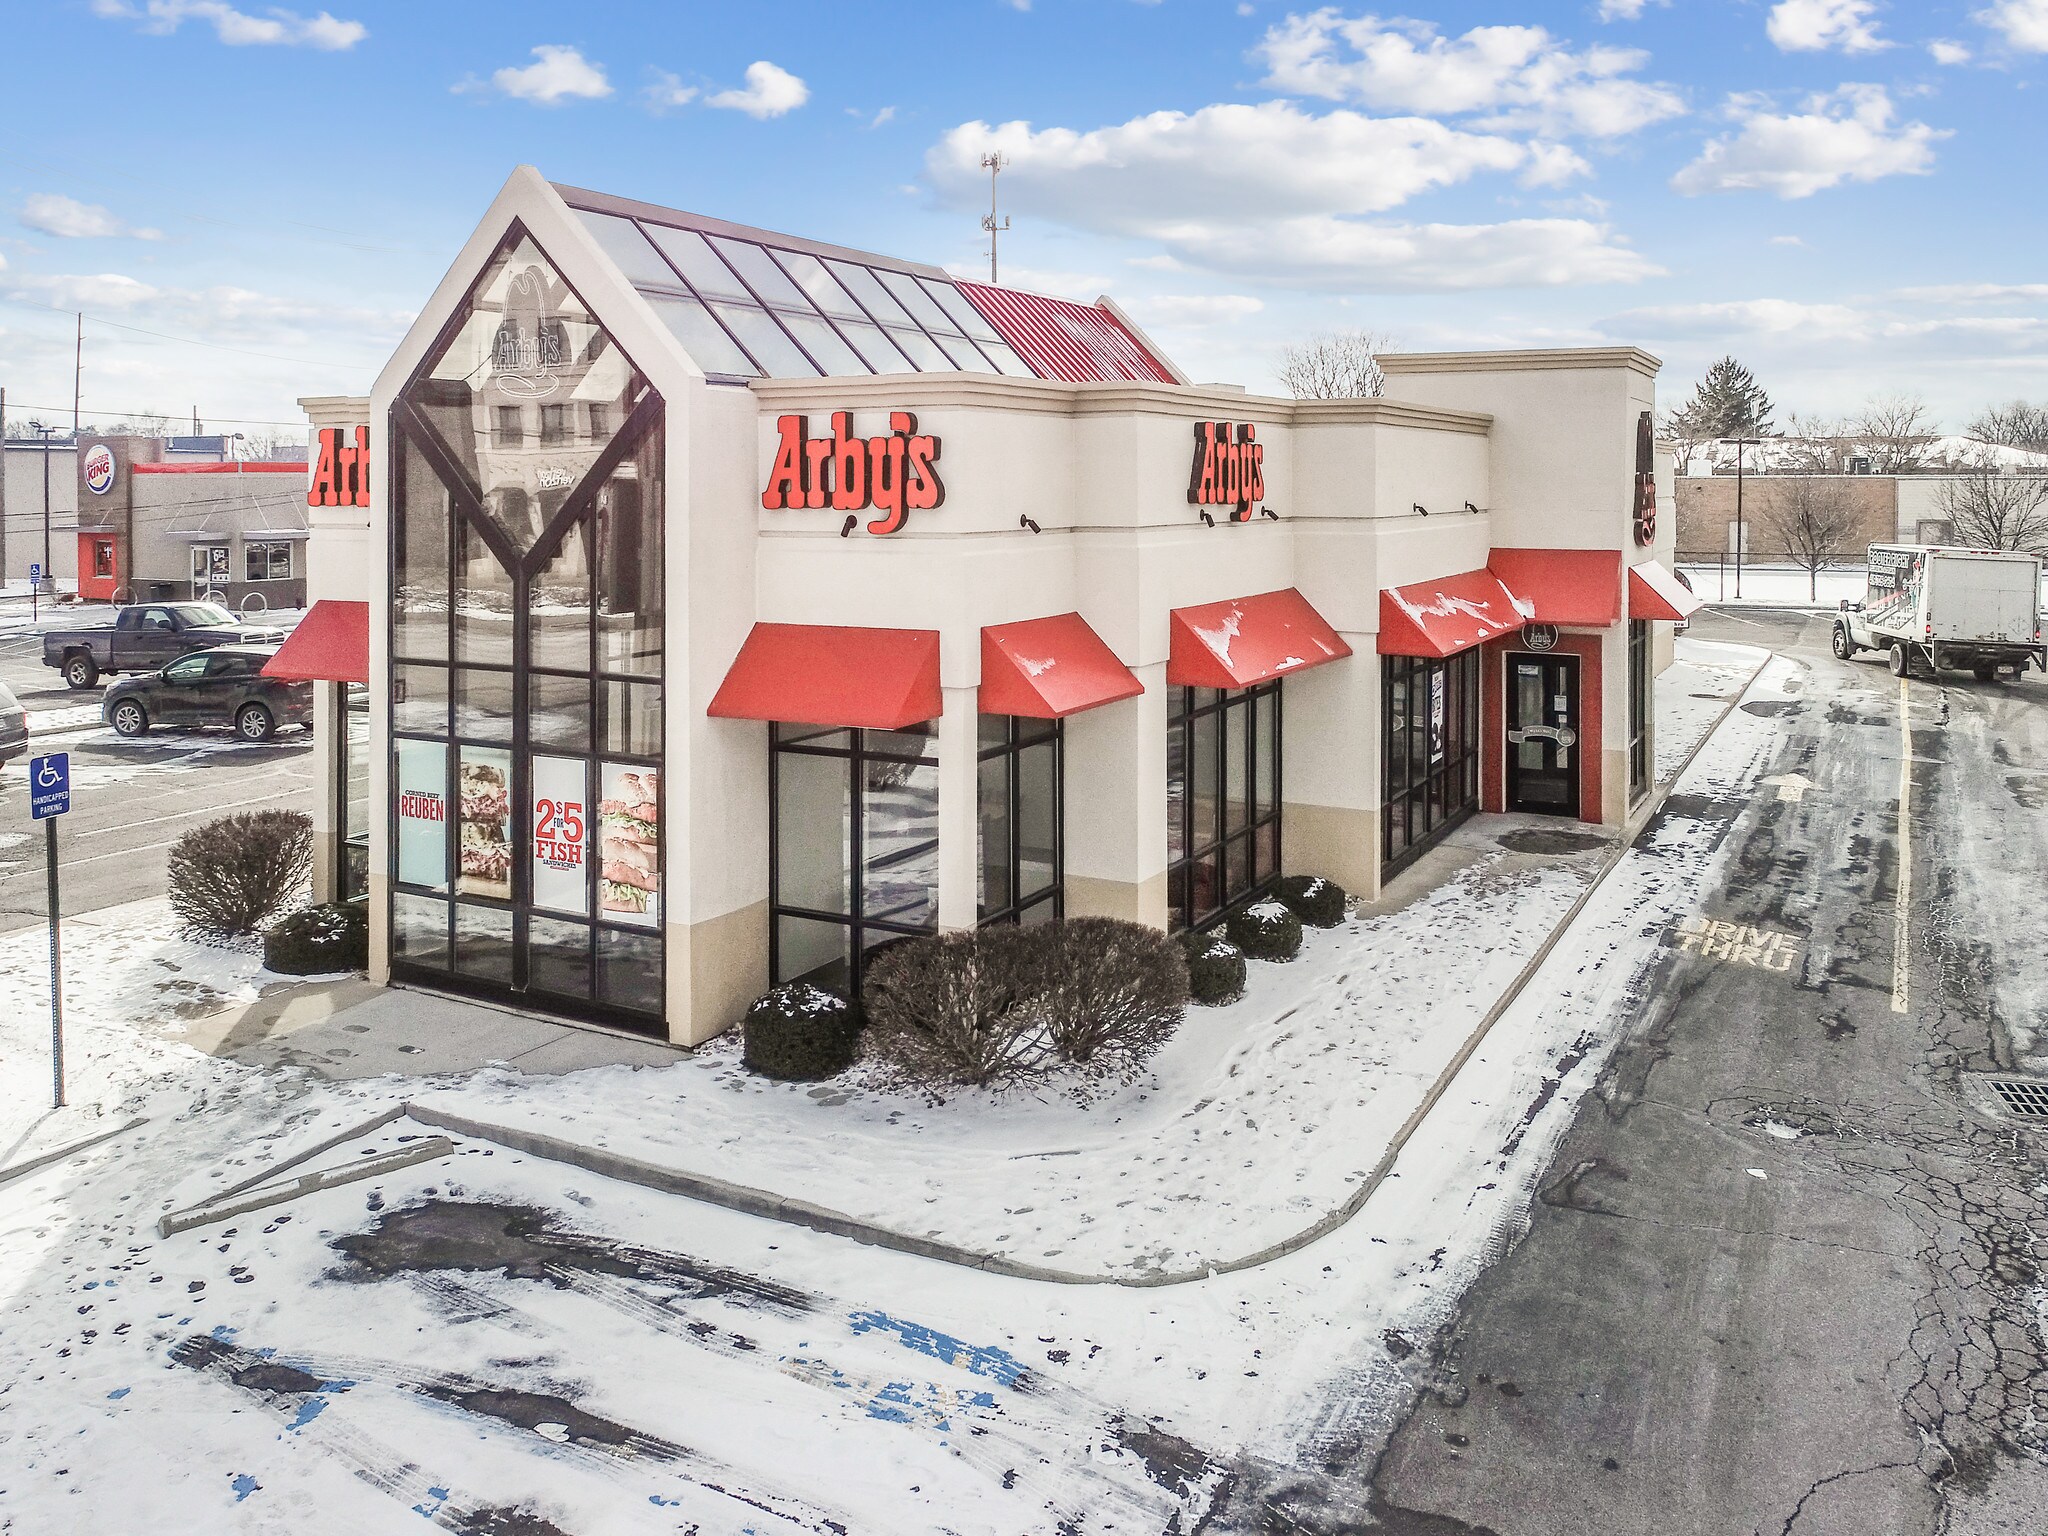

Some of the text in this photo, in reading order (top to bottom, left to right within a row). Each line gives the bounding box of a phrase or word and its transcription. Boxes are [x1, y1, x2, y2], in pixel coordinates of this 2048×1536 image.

[494, 326, 562, 379] Arby's
[87, 461, 110, 480] KING
[762, 411, 945, 535] Arby's
[1187, 421, 1265, 522] Arby's
[32, 790, 69, 806] HANDICAPPED
[40, 802, 63, 815] PARKING
[401, 794, 444, 822] REUBEN
[535, 798, 556, 840] 2
[553, 817, 565, 829] FOR
[535, 839, 583, 865] FISH
